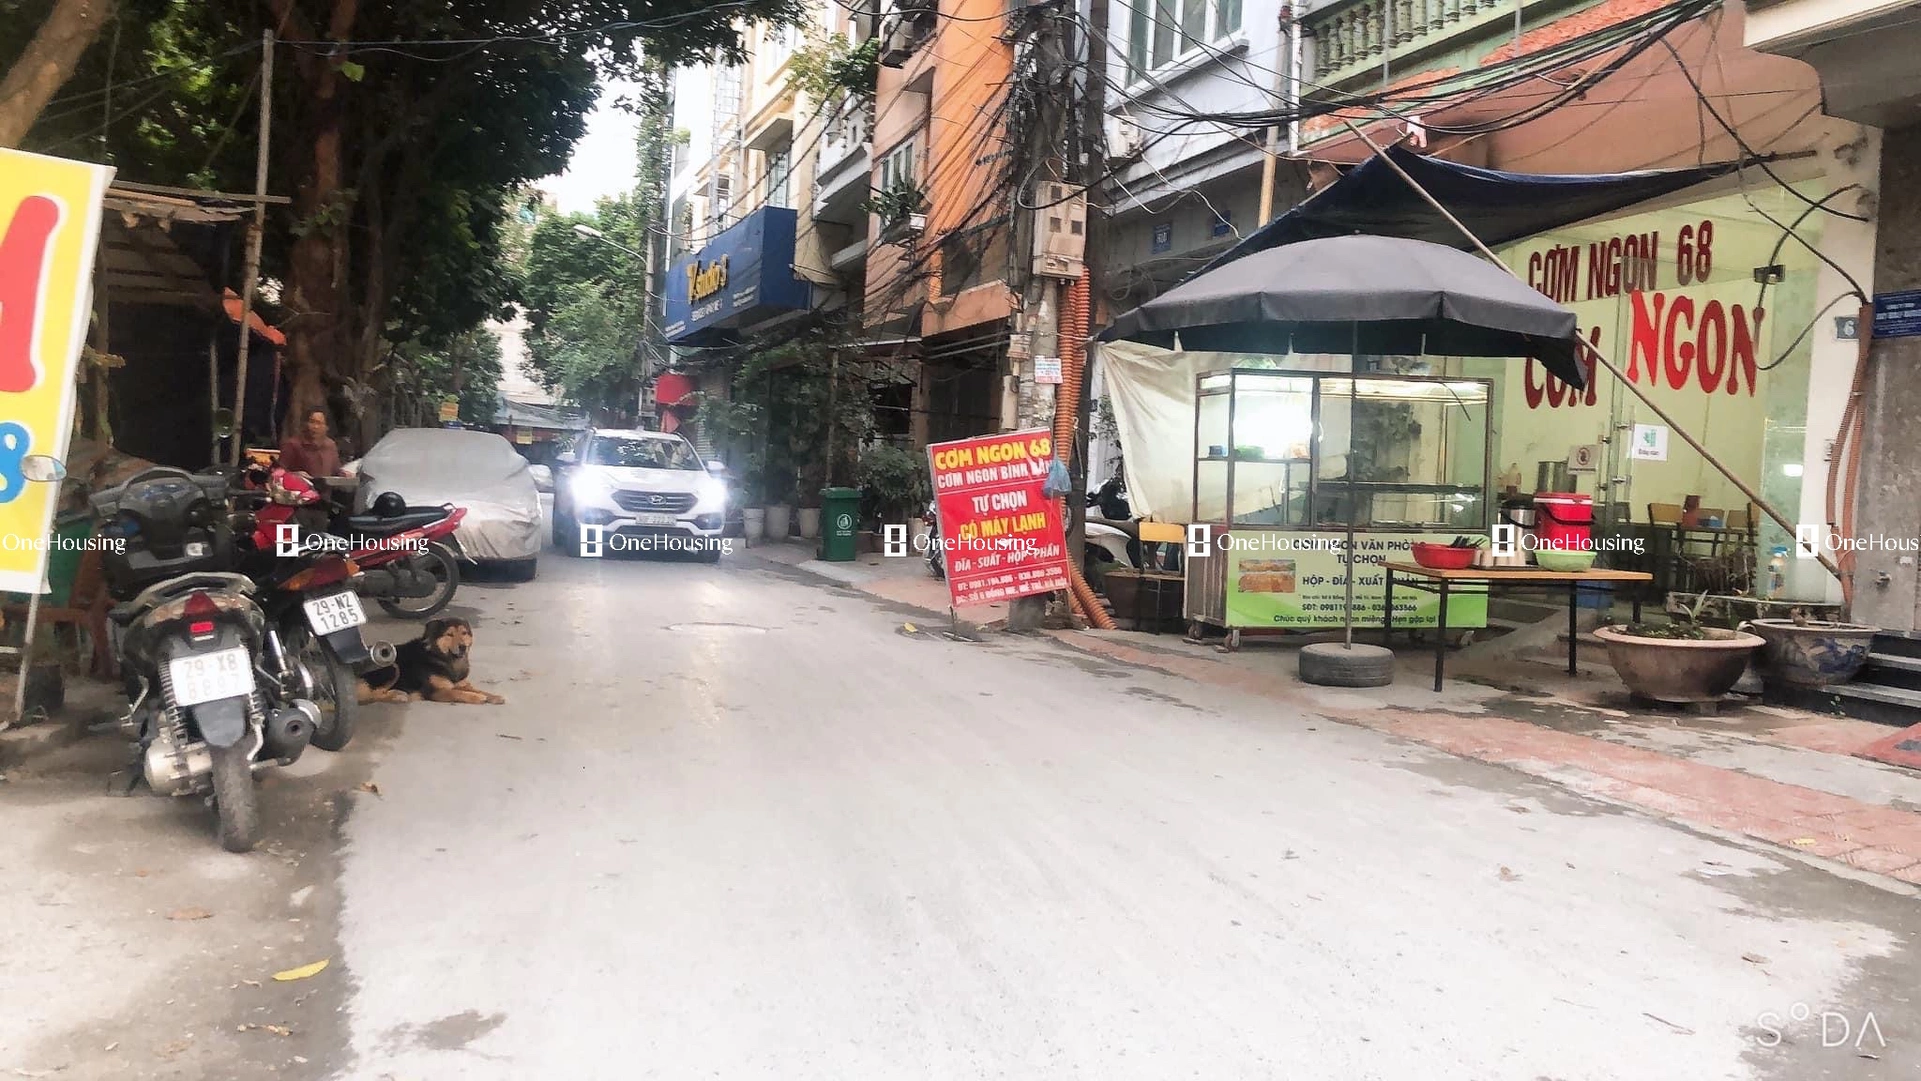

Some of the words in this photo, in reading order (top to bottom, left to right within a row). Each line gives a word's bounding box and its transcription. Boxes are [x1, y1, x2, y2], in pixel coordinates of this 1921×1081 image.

[1588, 231, 1659, 300] NGON
[1677, 220, 1713, 287] 68
[1627, 289, 1765, 398] NGON
[935, 448, 973, 470] CƠM
[976, 441, 1026, 465] NGON
[1029, 438, 1051, 457] 68
[938, 472, 963, 488] CƠM
[966, 466, 998, 484] NGON
[972, 494, 989, 516] TỰ
[991, 490, 1027, 512] CHỌN
[981, 515, 1009, 537] MÁY
[1011, 512, 1046, 535] LẠNH
[1361, 538, 1384, 550] VĂN
[1353, 554, 1386, 567] CHỌN
[1302, 574, 1324, 588] HỘP
[1358, 573, 1384, 586] XUẤT
[313, 594, 353, 617] 29-N2
[320, 608, 360, 630] 1285
